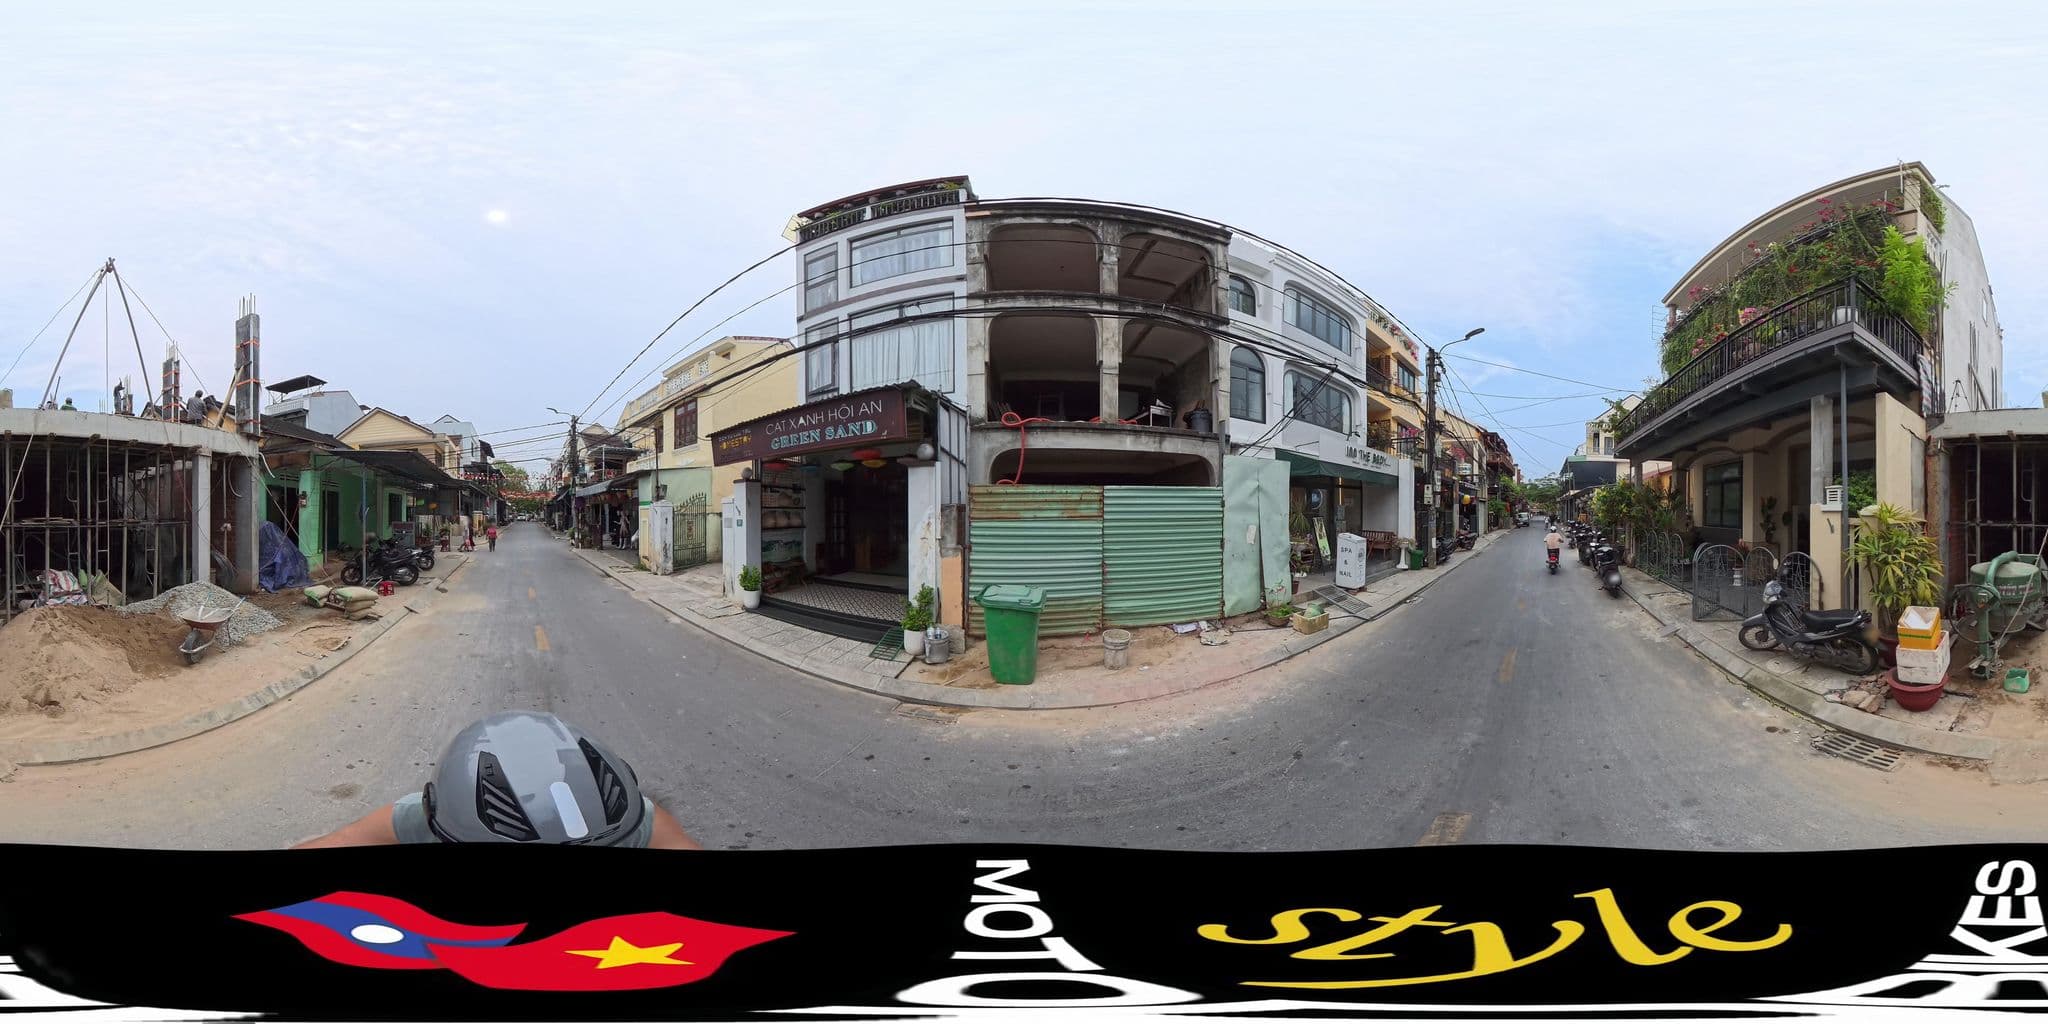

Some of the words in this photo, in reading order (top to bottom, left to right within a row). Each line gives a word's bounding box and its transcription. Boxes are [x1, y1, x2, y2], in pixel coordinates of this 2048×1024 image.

[788, 411, 824, 429] XANH
[858, 399, 882, 416] AN
[770, 428, 823, 450] GREEN
[825, 419, 878, 441] SAND
[1340, 546, 1353, 554] SPA
